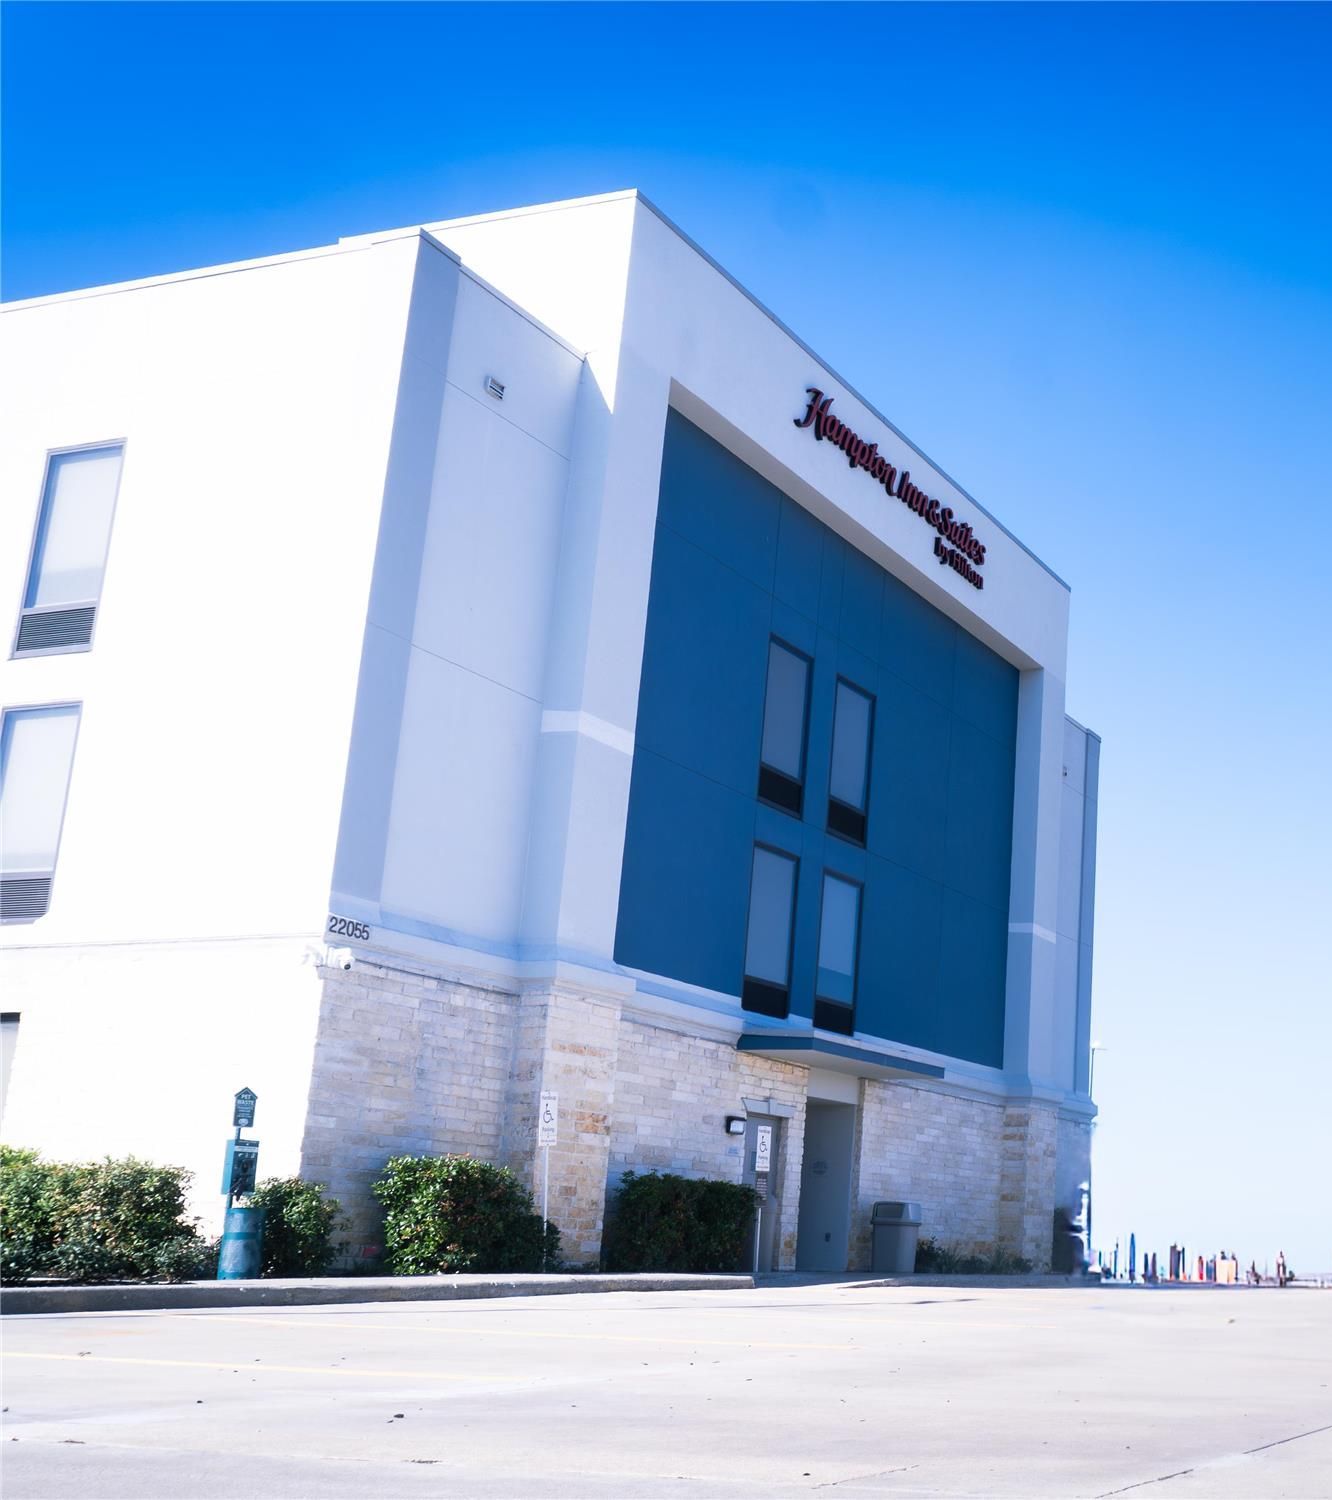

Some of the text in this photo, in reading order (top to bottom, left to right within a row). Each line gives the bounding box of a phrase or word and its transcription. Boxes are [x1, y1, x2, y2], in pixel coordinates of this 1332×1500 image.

[793, 388, 899, 497] Hampton
[934, 537, 984, 590] by Hilton
[329, 916, 370, 941] 22055
